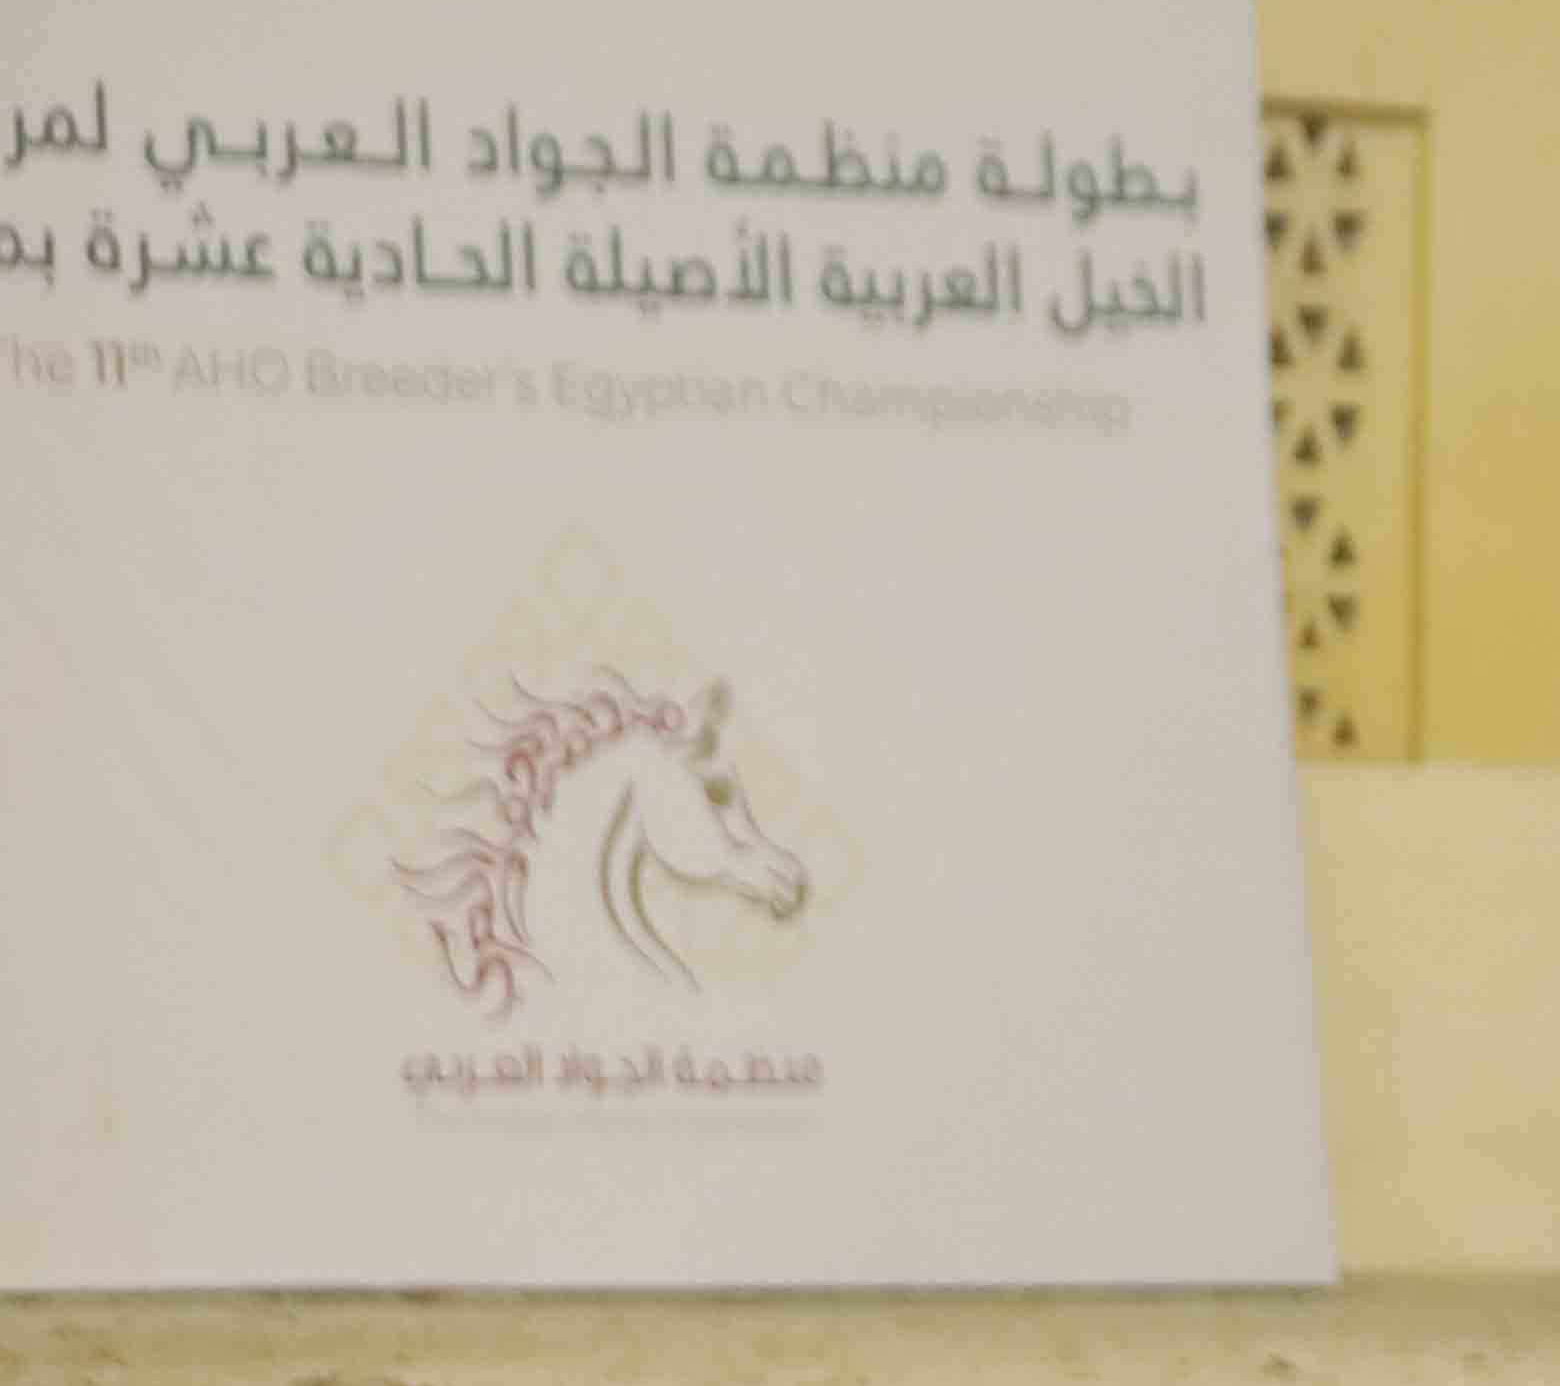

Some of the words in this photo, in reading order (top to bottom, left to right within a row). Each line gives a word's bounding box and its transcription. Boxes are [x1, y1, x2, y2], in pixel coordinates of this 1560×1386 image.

[143, 93, 432, 195] العربي
[467, 99, 675, 202] الجواد
[705, 117, 948, 195] منظمة
[976, 133, 1200, 231] بطولة
[86, 201, 276, 300] عشرة
[302, 213, 537, 307] الحادية
[565, 216, 793, 324] الأصيلة
[820, 239, 1025, 339] العربية
[1046, 247, 1206, 343] الخيل
[90, 338, 162, 389] 11th
[172, 345, 290, 393] AHO
[304, 348, 540, 405] Breeder's
[551, 360, 766, 425] Egyptian
